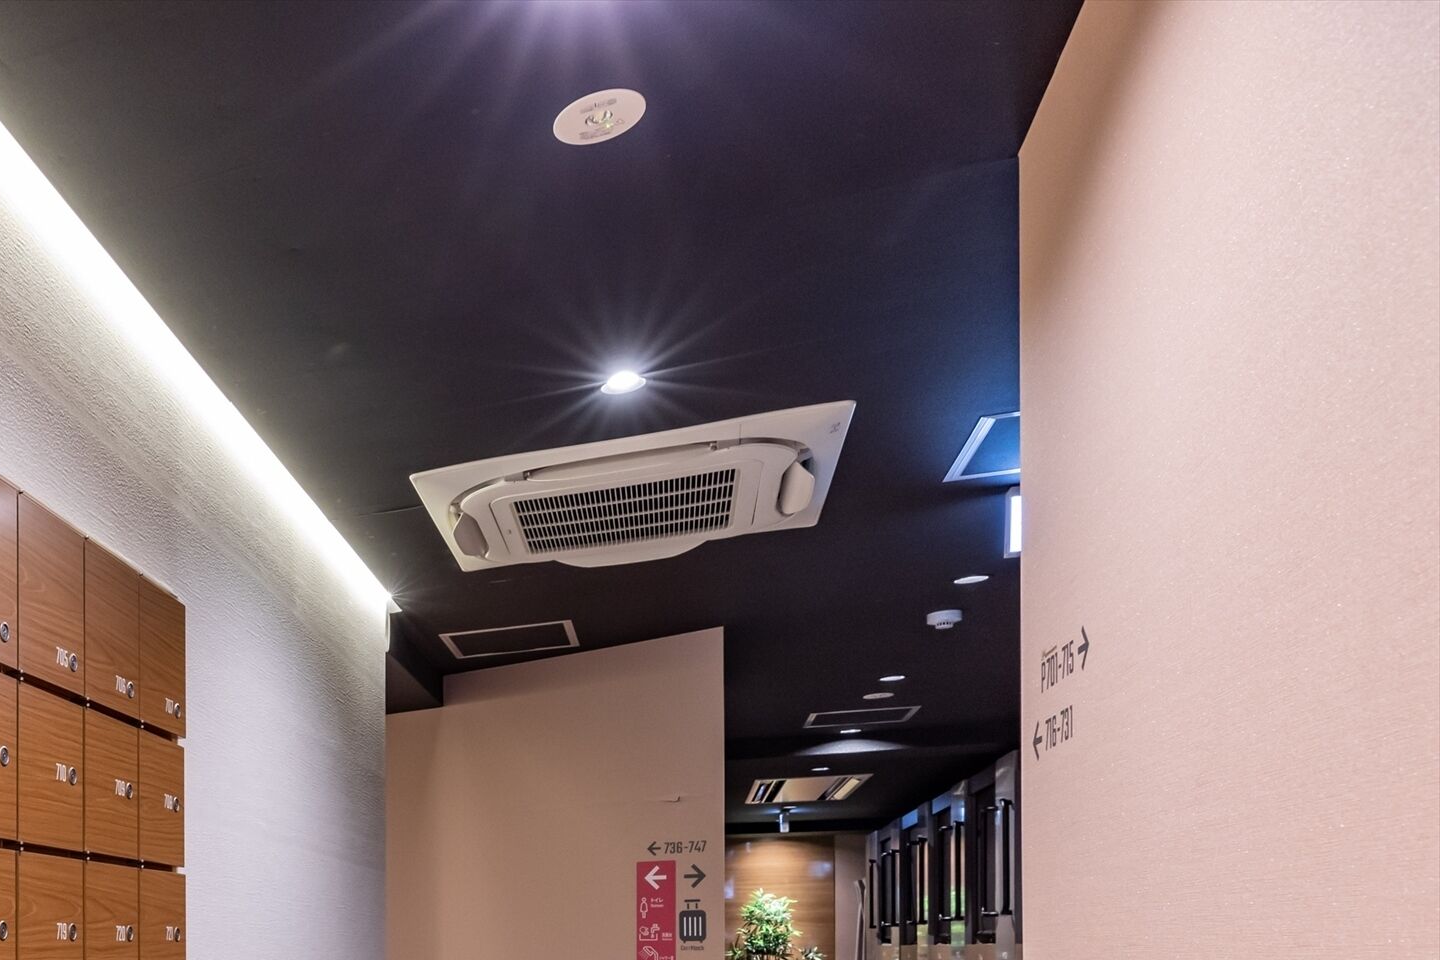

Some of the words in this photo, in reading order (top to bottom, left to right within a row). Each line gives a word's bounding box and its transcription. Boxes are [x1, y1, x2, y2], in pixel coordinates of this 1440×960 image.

[1041, 640, 1075, 694] P701-715
[1045, 705, 1073, 751] 716-731
[663, 840, 707, 854] 736-747
